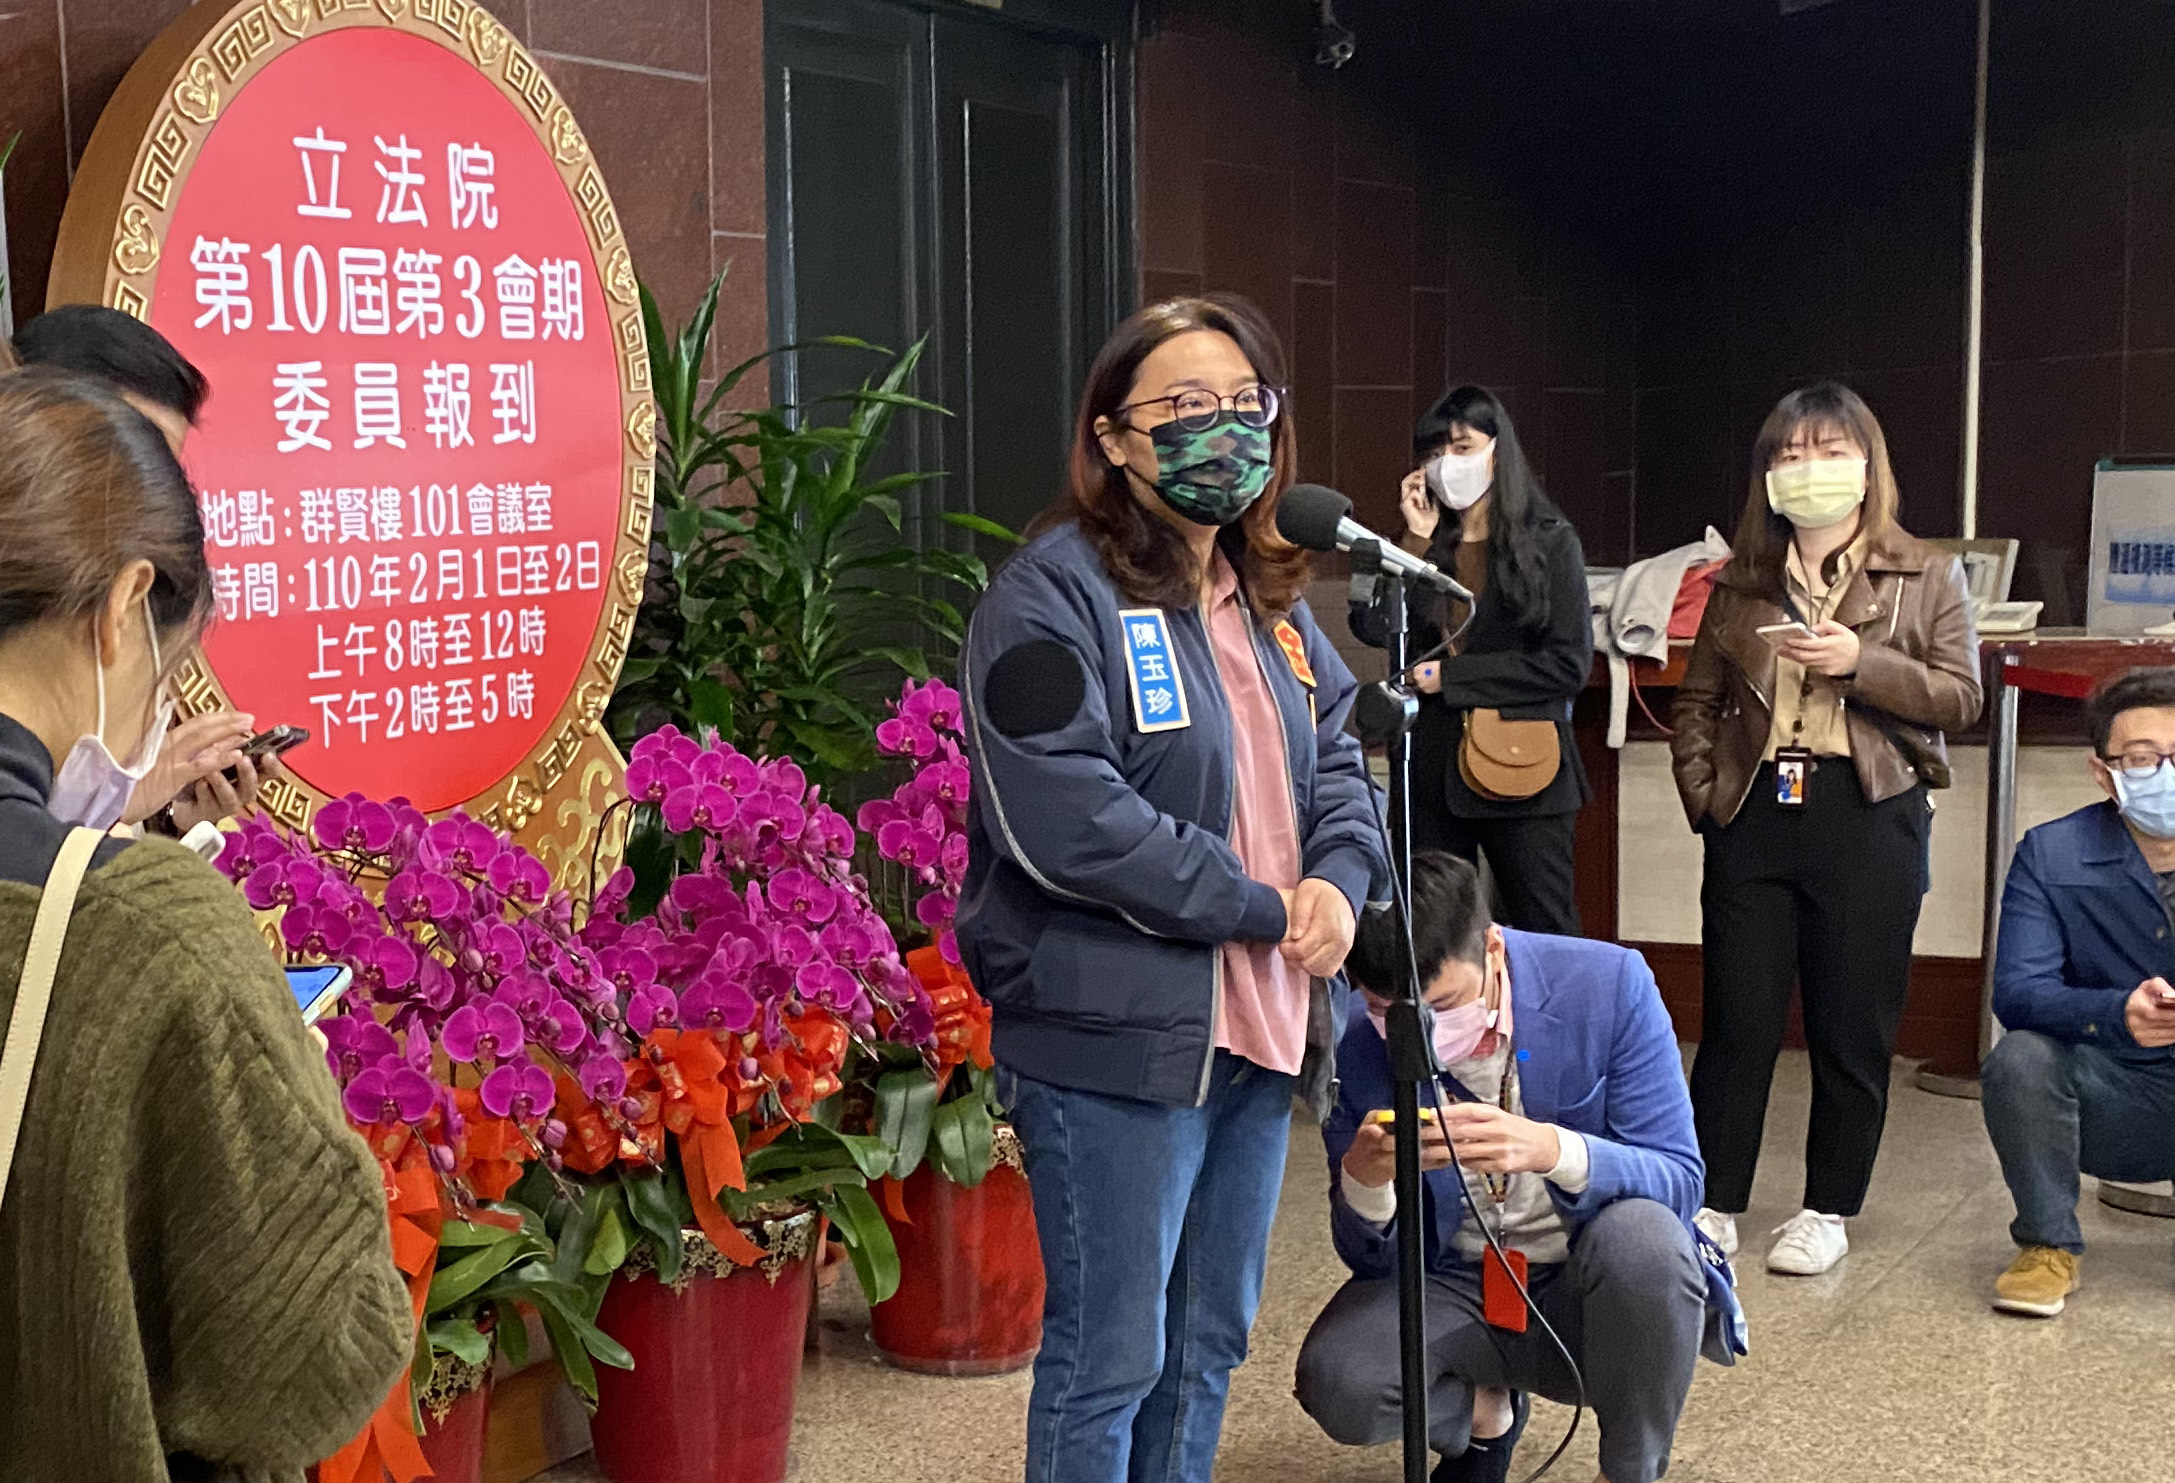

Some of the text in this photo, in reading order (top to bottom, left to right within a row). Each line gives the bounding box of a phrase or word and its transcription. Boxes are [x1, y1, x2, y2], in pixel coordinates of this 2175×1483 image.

[293, 126, 498, 230] 立法院
[190, 235, 585, 341] 第10屆第3會期
[273, 360, 537, 453] 委員報到
[308, 605, 547, 679] 上午8時至12時
[1131, 623, 1173, 715] 陳玉珍
[309, 669, 535, 748] 下午2時至5時
